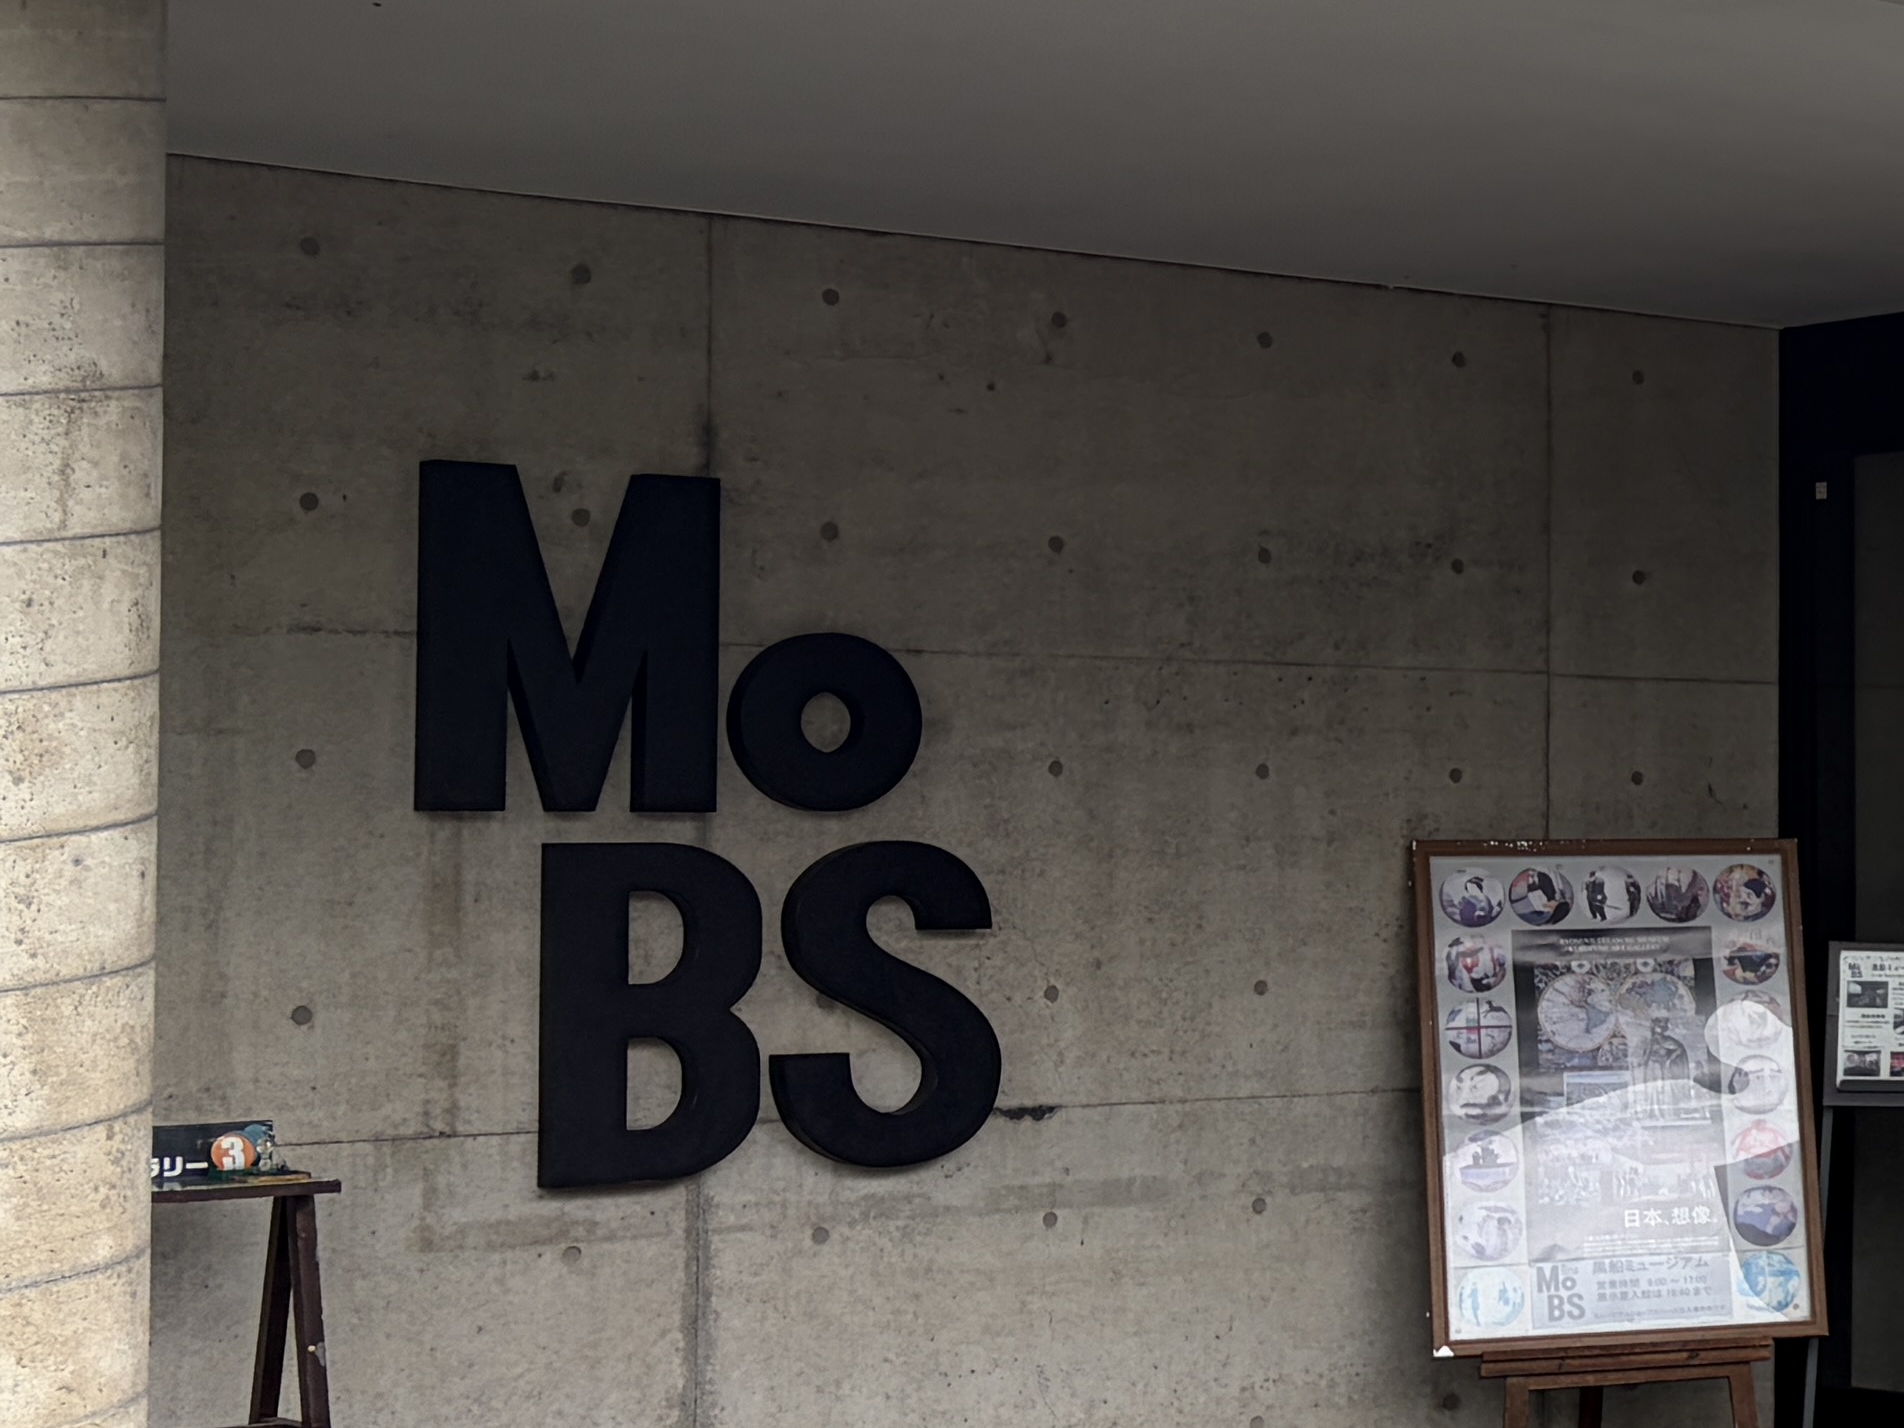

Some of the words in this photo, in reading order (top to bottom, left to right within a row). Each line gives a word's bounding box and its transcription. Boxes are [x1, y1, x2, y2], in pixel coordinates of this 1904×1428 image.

[414, 459, 922, 813] Mo
[538, 840, 1002, 1189] BS
[221, 1136, 246, 1171] 3
[1624, 1206, 1718, 1228] 日本、想像。
[1536, 1264, 1577, 1293] Mo
[1592, 1256, 1709, 1275] 黒船ミュージアム
[1547, 1293, 1586, 1322] BS
